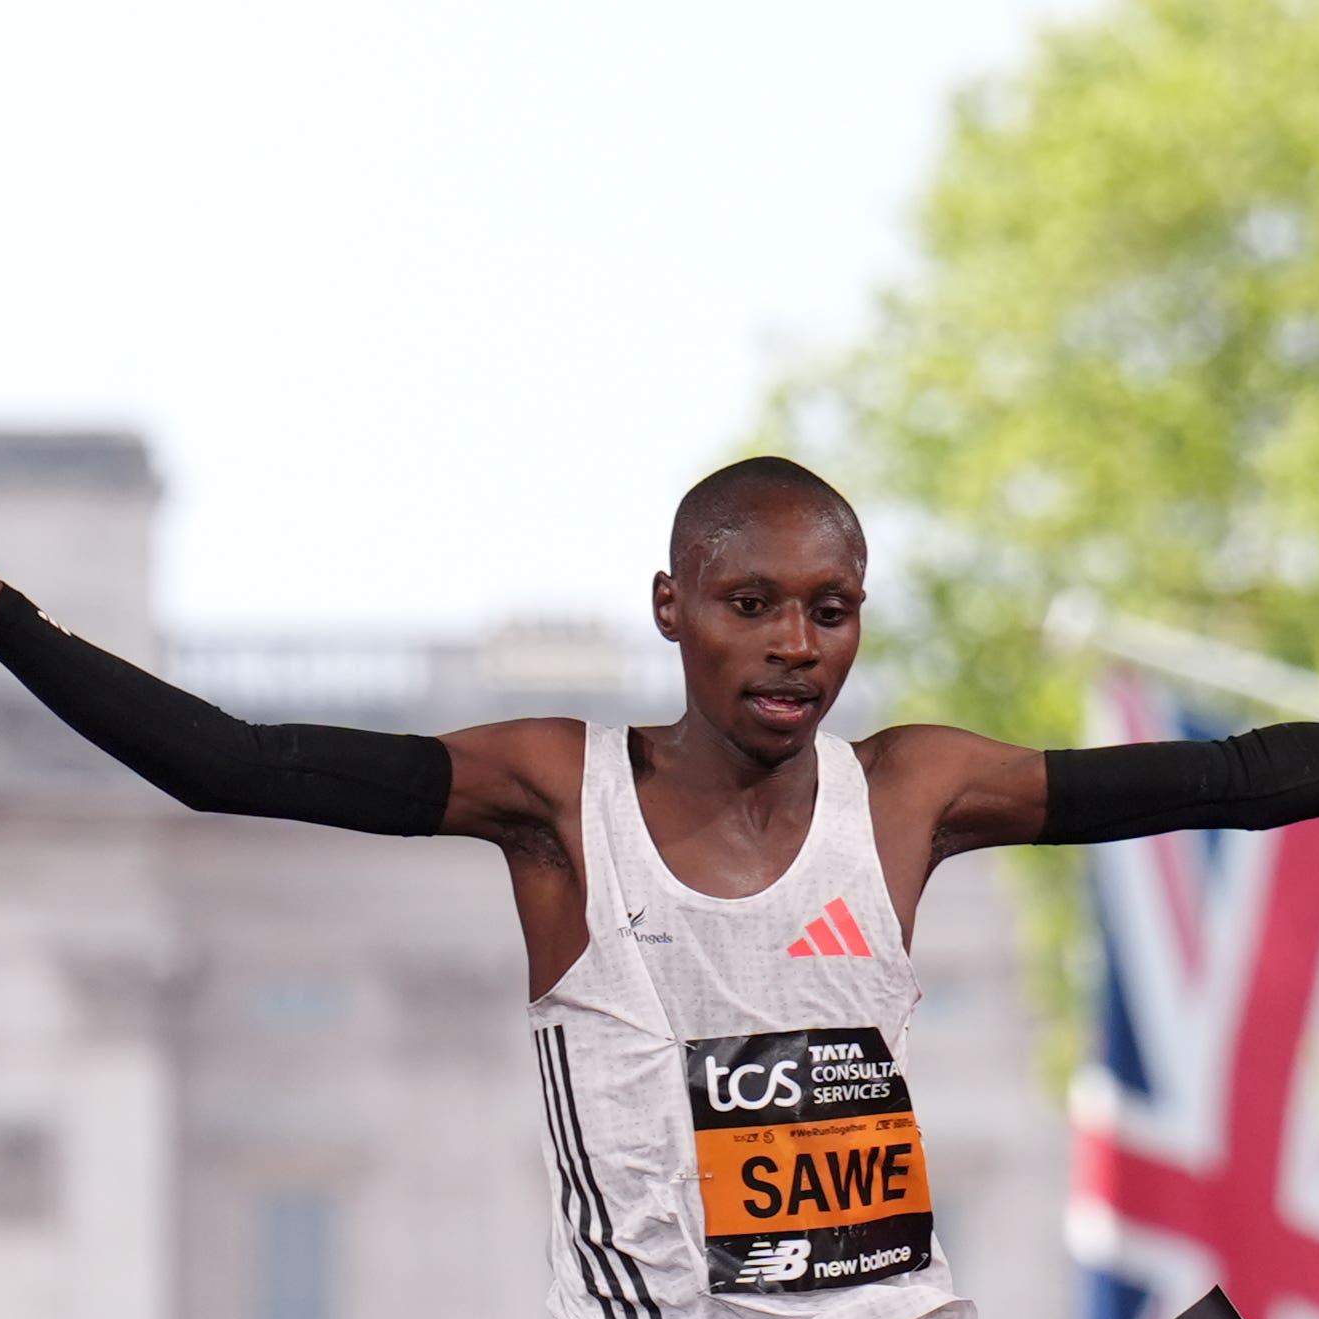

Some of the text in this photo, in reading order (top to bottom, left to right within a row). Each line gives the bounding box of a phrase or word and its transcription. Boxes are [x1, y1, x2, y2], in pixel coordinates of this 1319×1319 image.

[809, 1043, 864, 1062] TATA
[705, 1055, 802, 1112] tcs
[811, 1061, 902, 1083] CONSULTA
[814, 1082, 891, 1105] SERVICES
[741, 1143, 912, 1219] SAWE
[814, 1257, 858, 1279] new
[860, 1245, 912, 1273] balance
